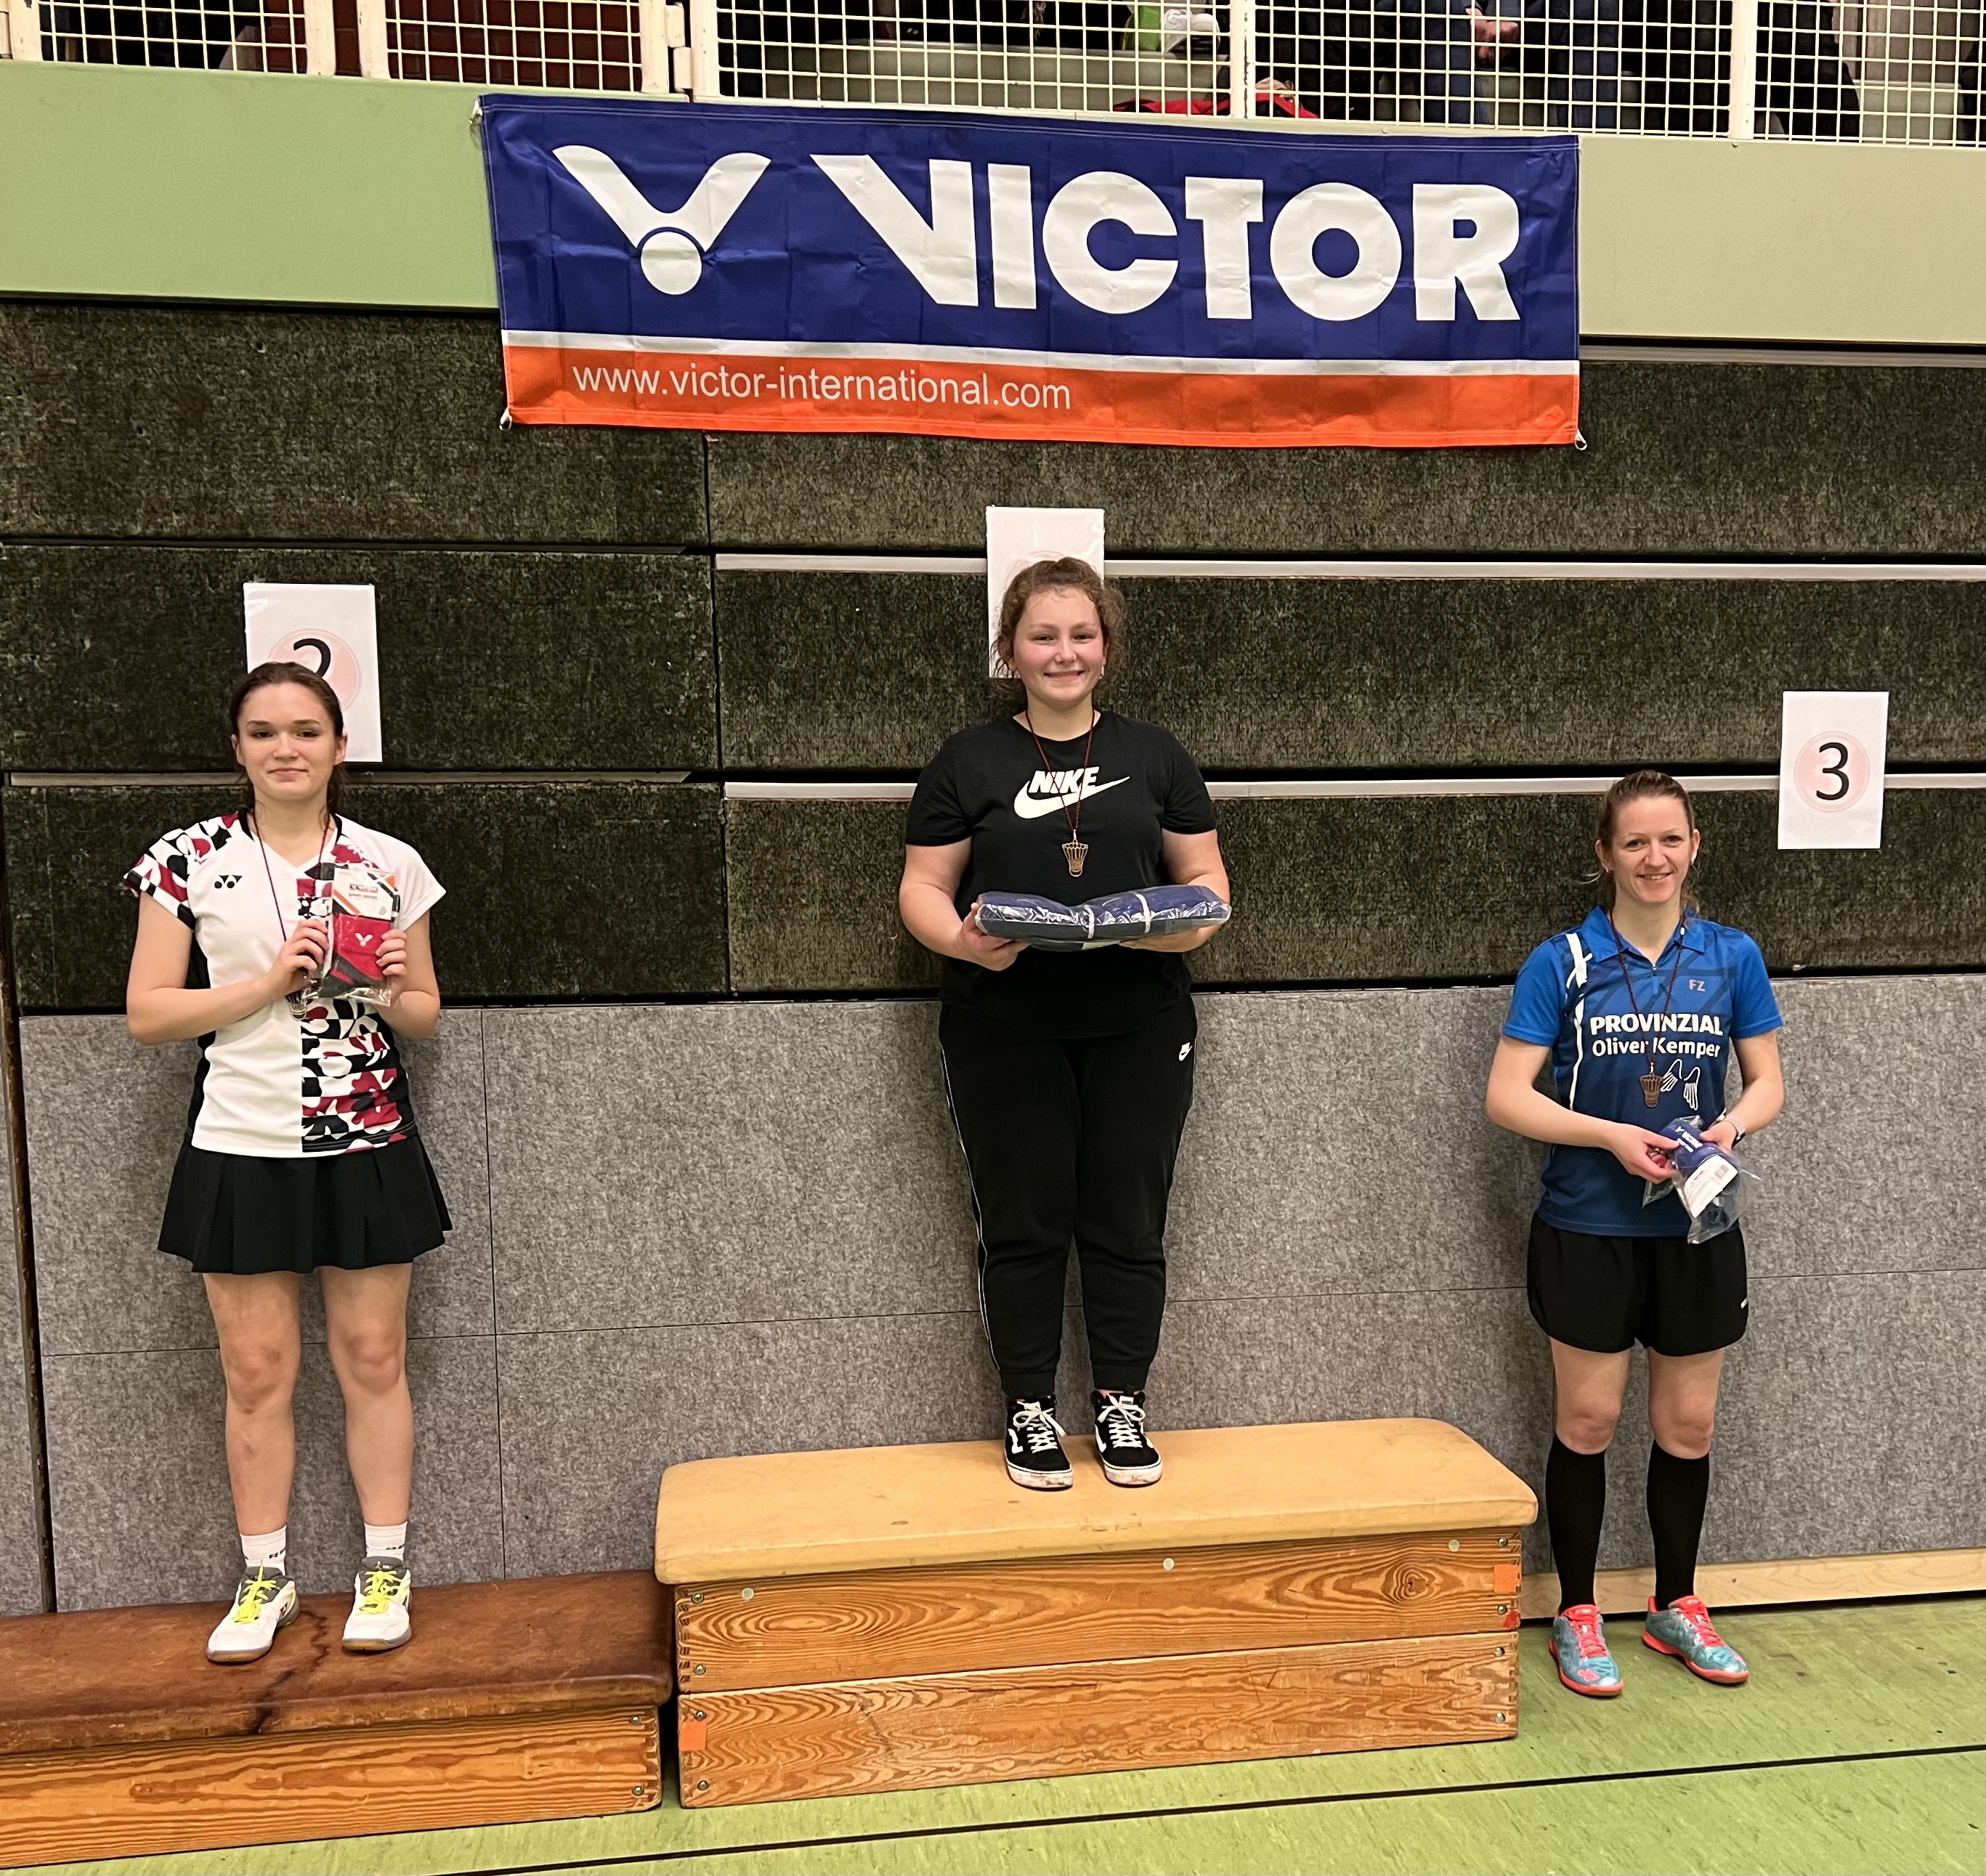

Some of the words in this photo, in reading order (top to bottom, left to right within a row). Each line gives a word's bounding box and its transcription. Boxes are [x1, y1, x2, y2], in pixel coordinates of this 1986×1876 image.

[810, 154, 1520, 320] VICTOR
[572, 363, 1071, 409] www.victor-international.com
[1029, 766, 1100, 793] NIKE
[1816, 742, 1849, 800] 3
[1689, 979, 1706, 991] FZ
[1590, 1013, 1723, 1036] PROVINZIAL
[1592, 1037, 1649, 1056] Oliver
[1653, 1037, 1721, 1058] Kemper
